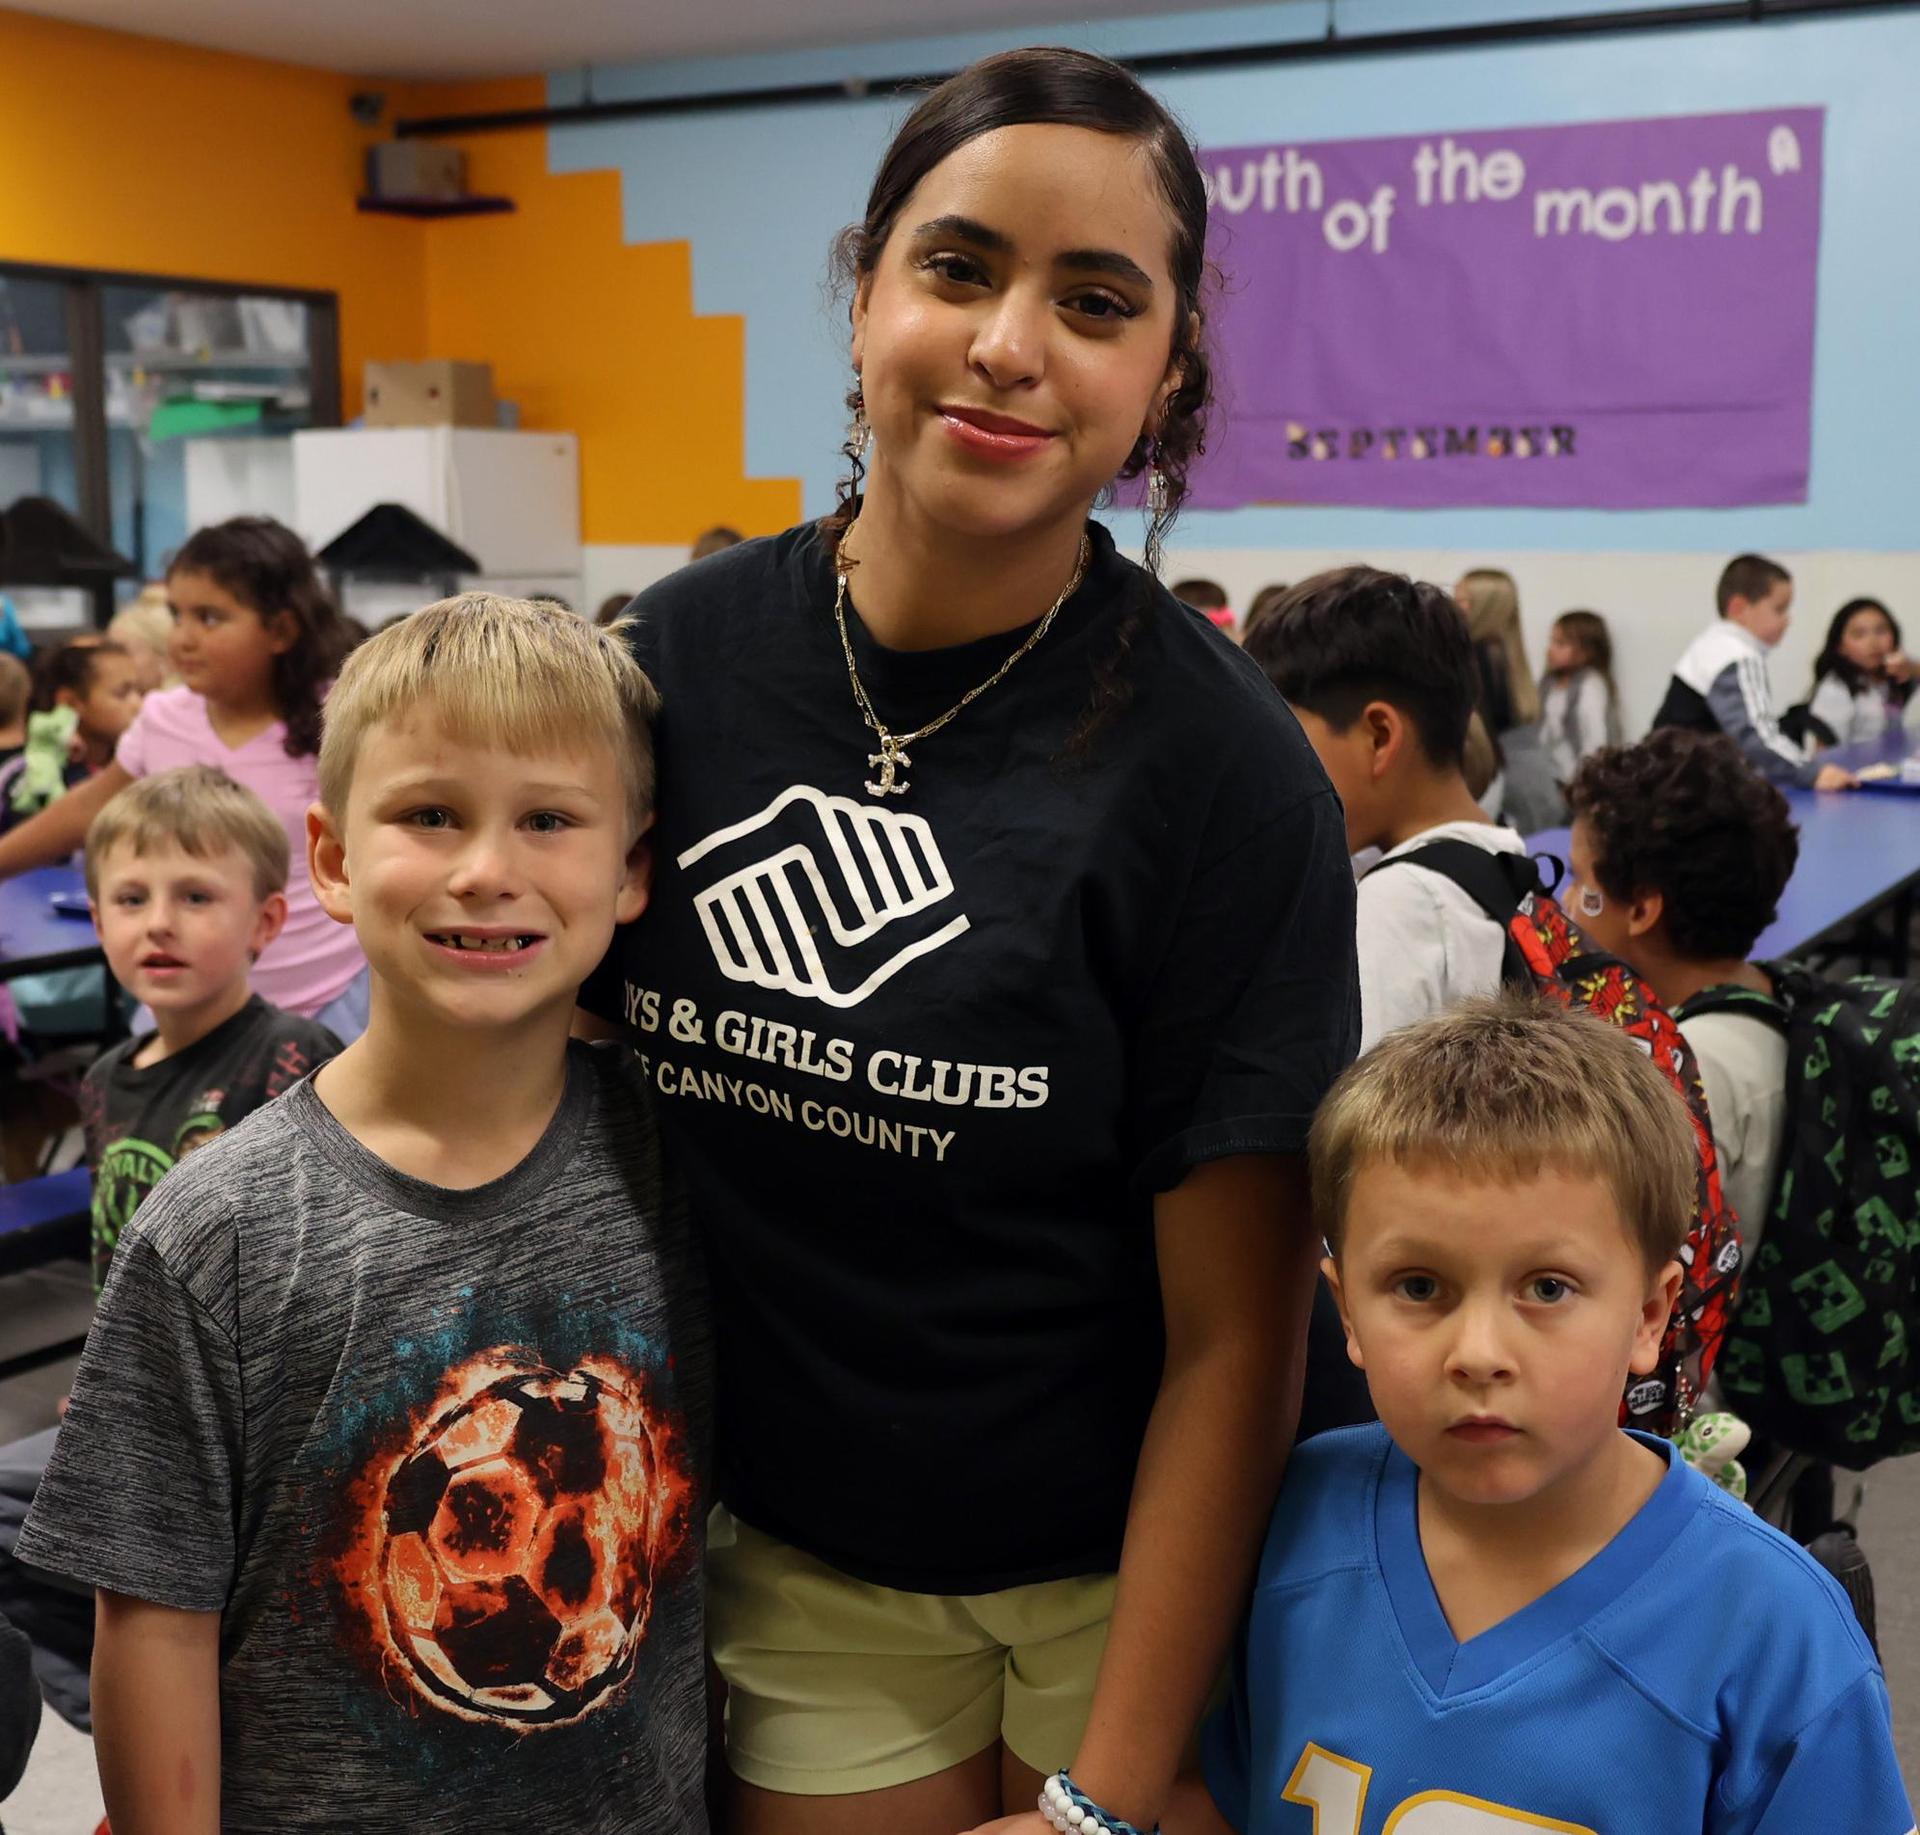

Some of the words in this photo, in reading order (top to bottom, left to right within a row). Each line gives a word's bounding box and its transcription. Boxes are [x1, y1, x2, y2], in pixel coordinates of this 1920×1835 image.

[1205, 148, 1325, 215] uth
[1321, 183, 1397, 254] of
[1413, 138, 1526, 208] the
[1533, 163, 1764, 240] month
[668, 998, 707, 1045] &
[715, 1010, 855, 1082] GIRLS
[867, 1050, 1050, 1109] CLUBS
[657, 1061, 794, 1122] CANYON
[801, 1100, 956, 1162] COUNTY
